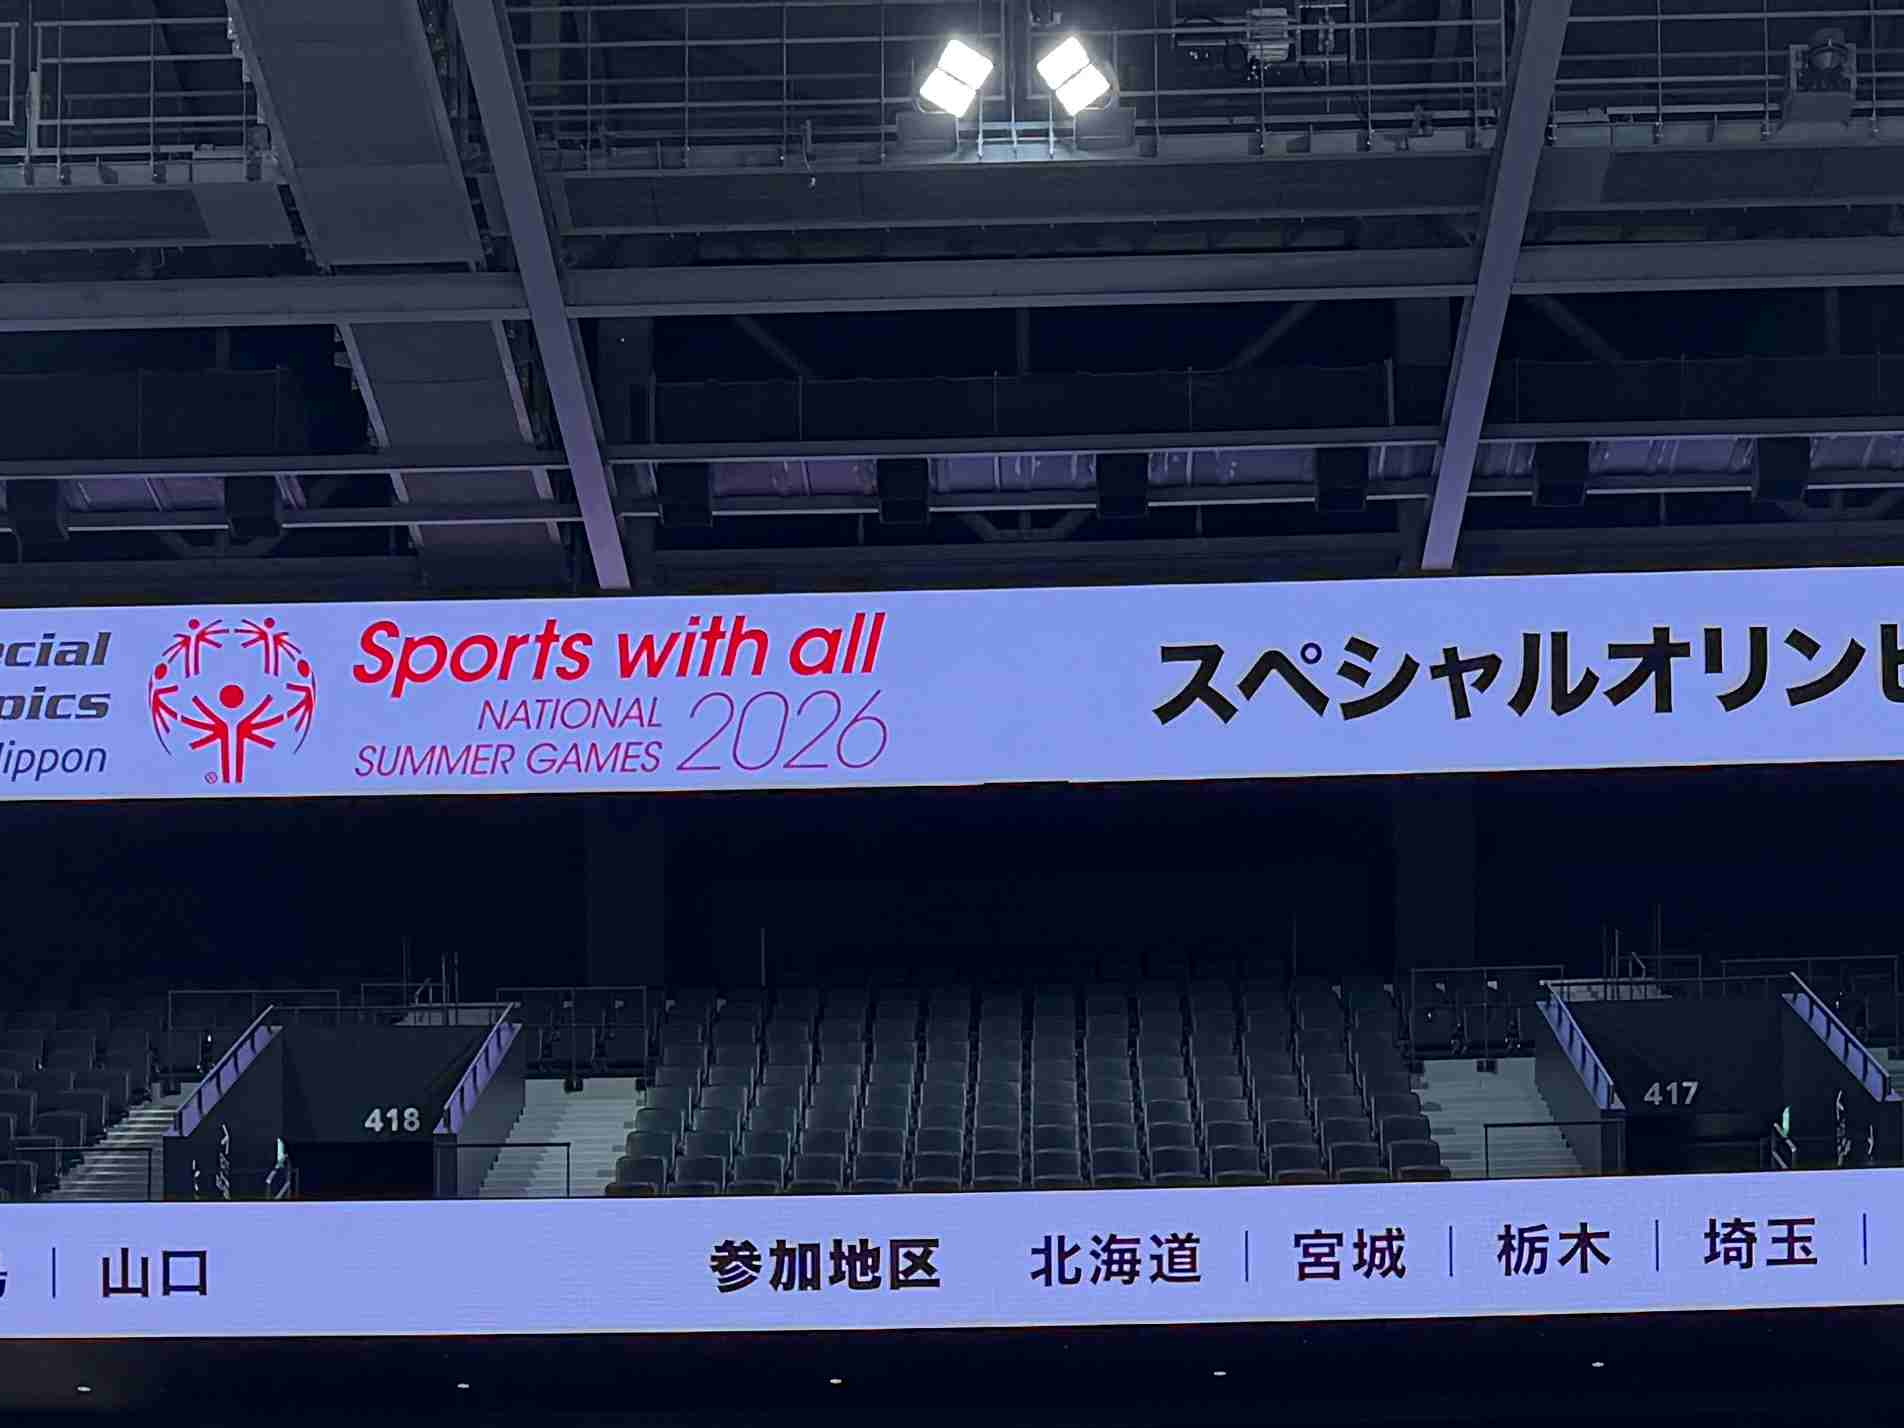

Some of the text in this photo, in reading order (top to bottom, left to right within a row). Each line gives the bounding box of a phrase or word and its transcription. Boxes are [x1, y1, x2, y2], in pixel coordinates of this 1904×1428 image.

[353, 611, 888, 698] Sports with all
[354, 688, 889, 778] SUMMER GAMES 2026
[477, 696, 664, 731] NATIONAL
[1643, 1080, 1699, 1105] 417
[364, 1107, 421, 1132] 418
[101, 1247, 209, 1298] 山口
[709, 1238, 942, 1294] 参加地区
[1030, 1232, 1202, 1288] 北海道
[1293, 1227, 1407, 1282] 宮城
[1496, 1221, 1612, 1277] 栃木
[1703, 1216, 1819, 1270] 埼玉
